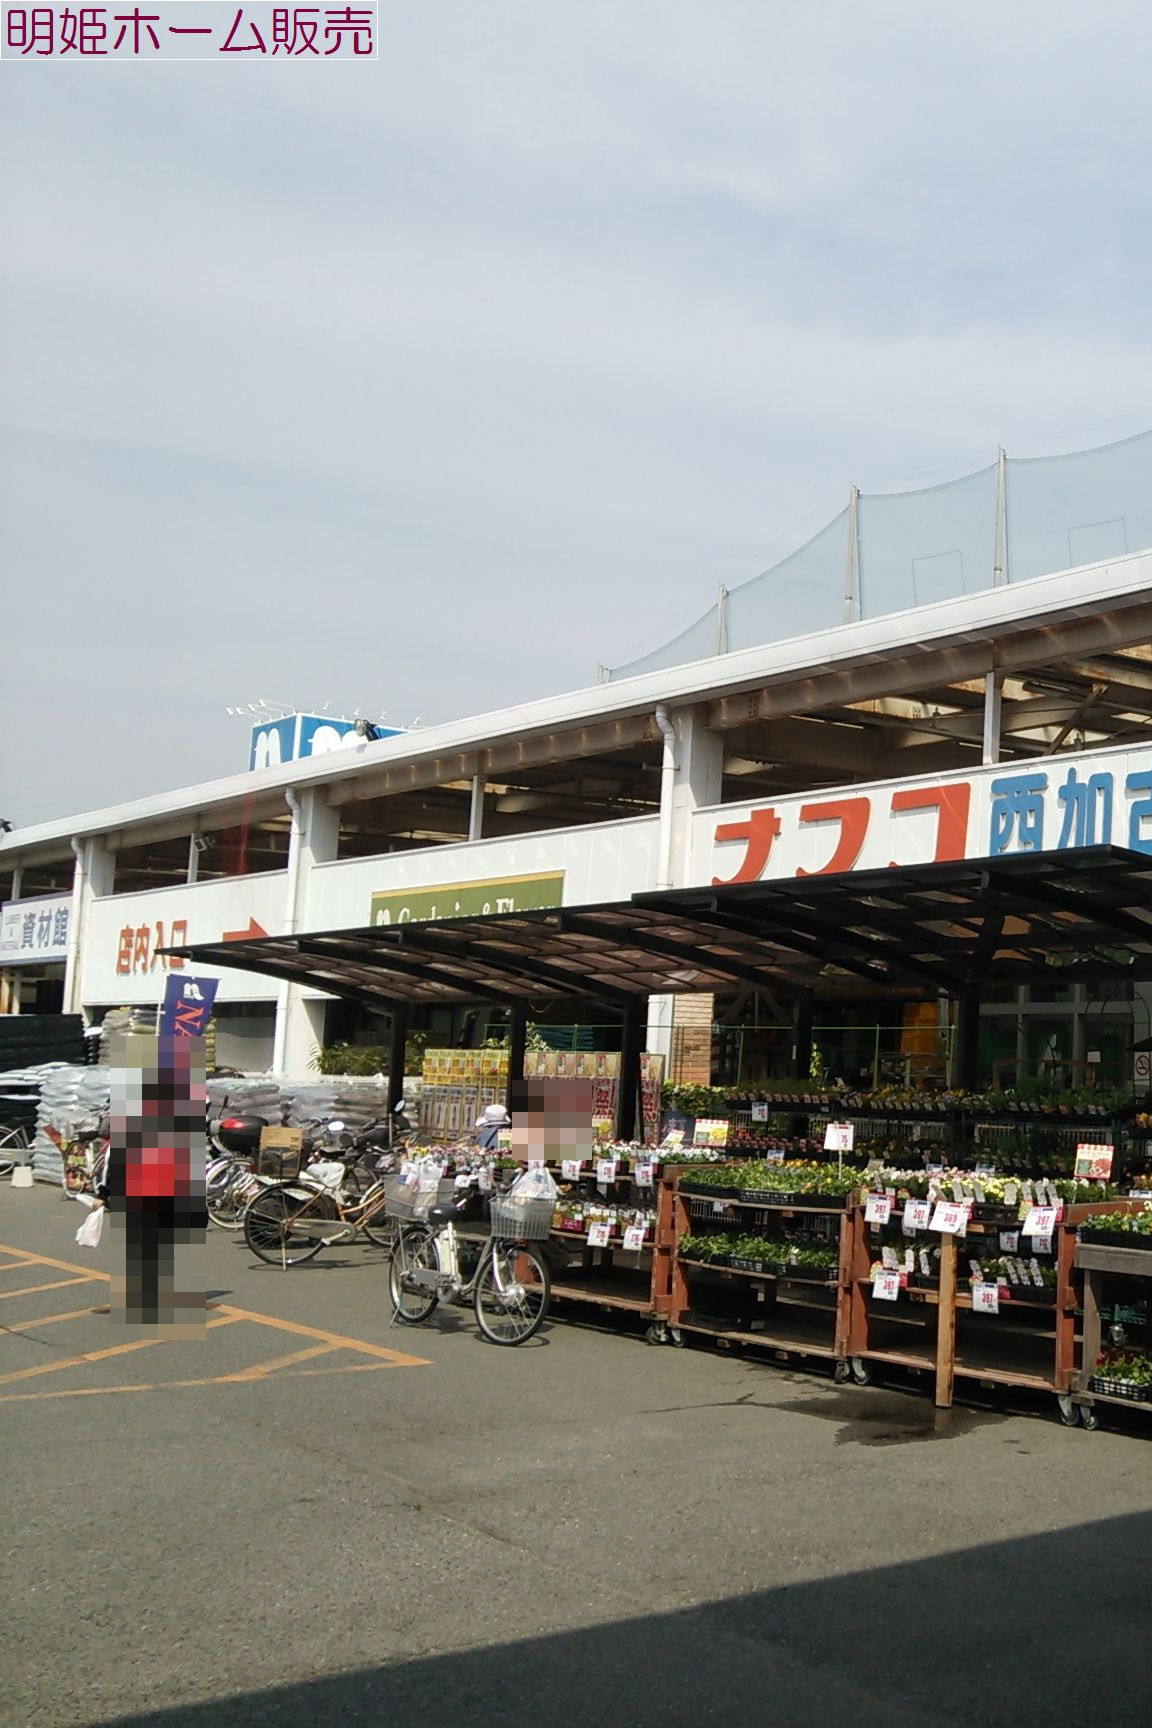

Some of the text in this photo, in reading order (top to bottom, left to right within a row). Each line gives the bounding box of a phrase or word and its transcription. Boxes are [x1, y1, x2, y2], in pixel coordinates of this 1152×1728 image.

[116, 919, 188, 975] 店内入口
[1035, 1215, 1050, 1226] 397
